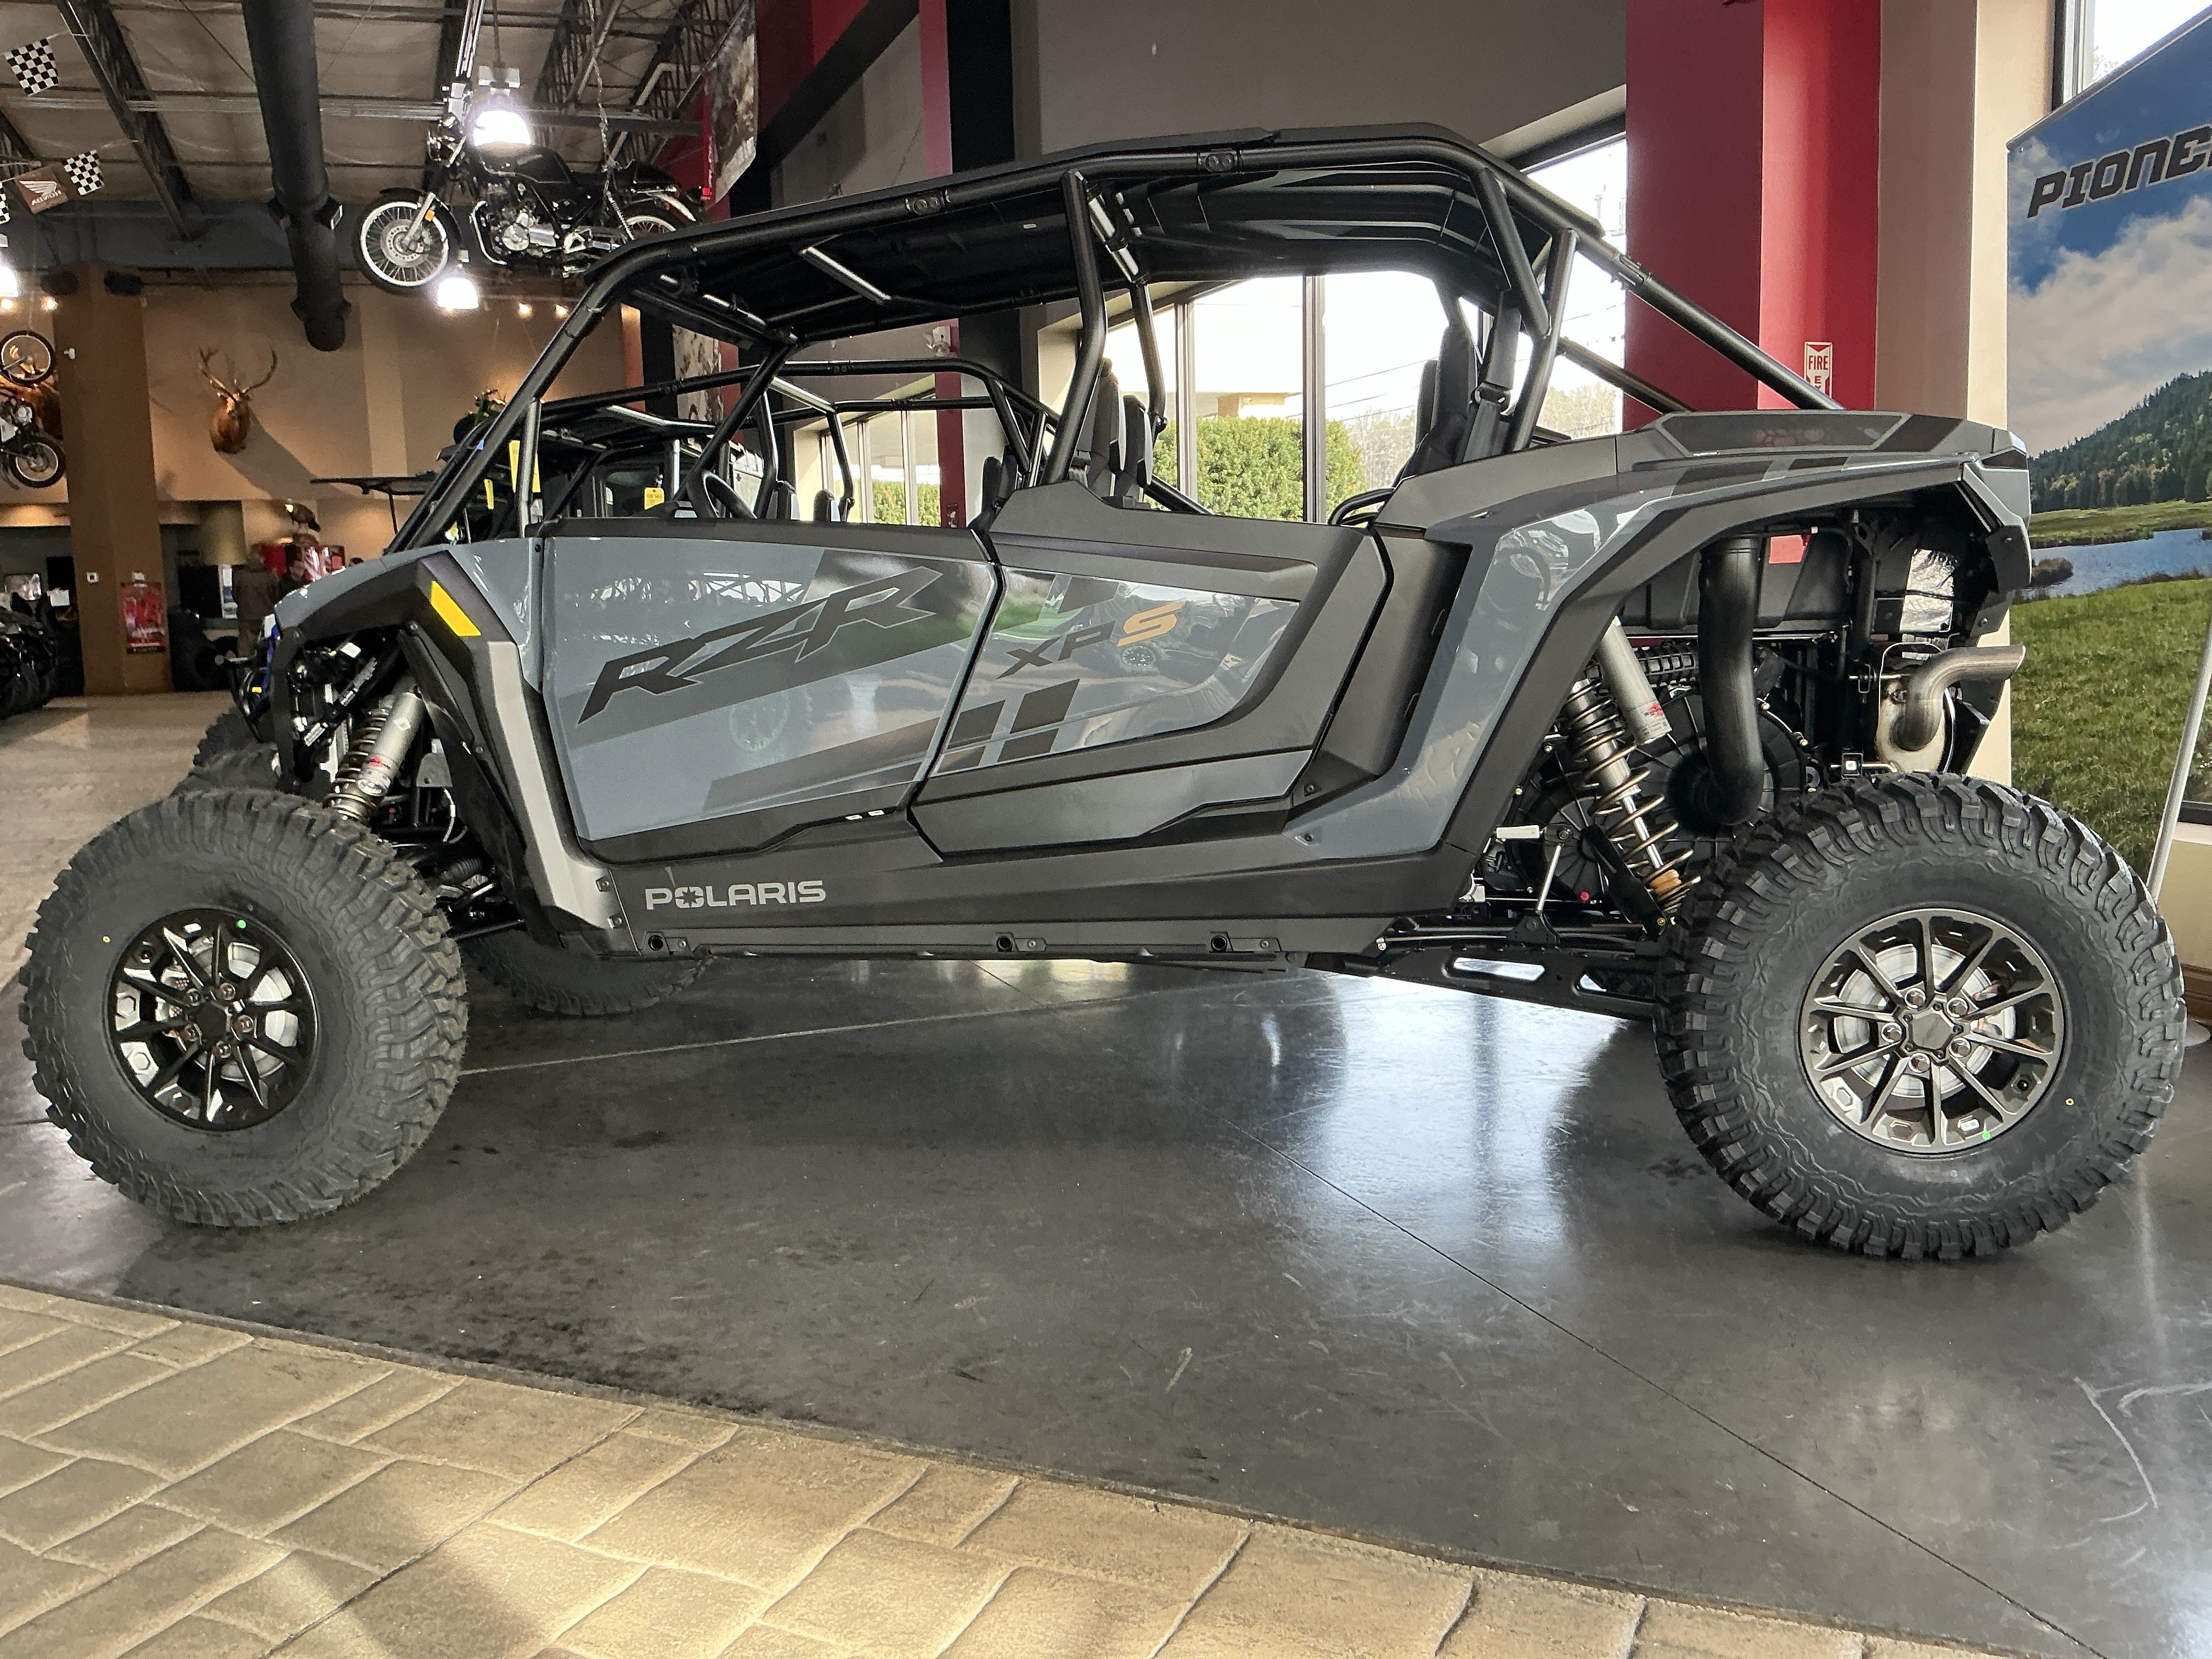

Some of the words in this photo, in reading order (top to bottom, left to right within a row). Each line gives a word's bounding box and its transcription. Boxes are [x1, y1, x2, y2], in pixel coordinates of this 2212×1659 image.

[2027, 125, 2212, 218] PIONE
[1809, 356, 1829, 370] FIRE
[577, 566, 944, 725] RZR
[645, 881, 826, 910] POLARIS
